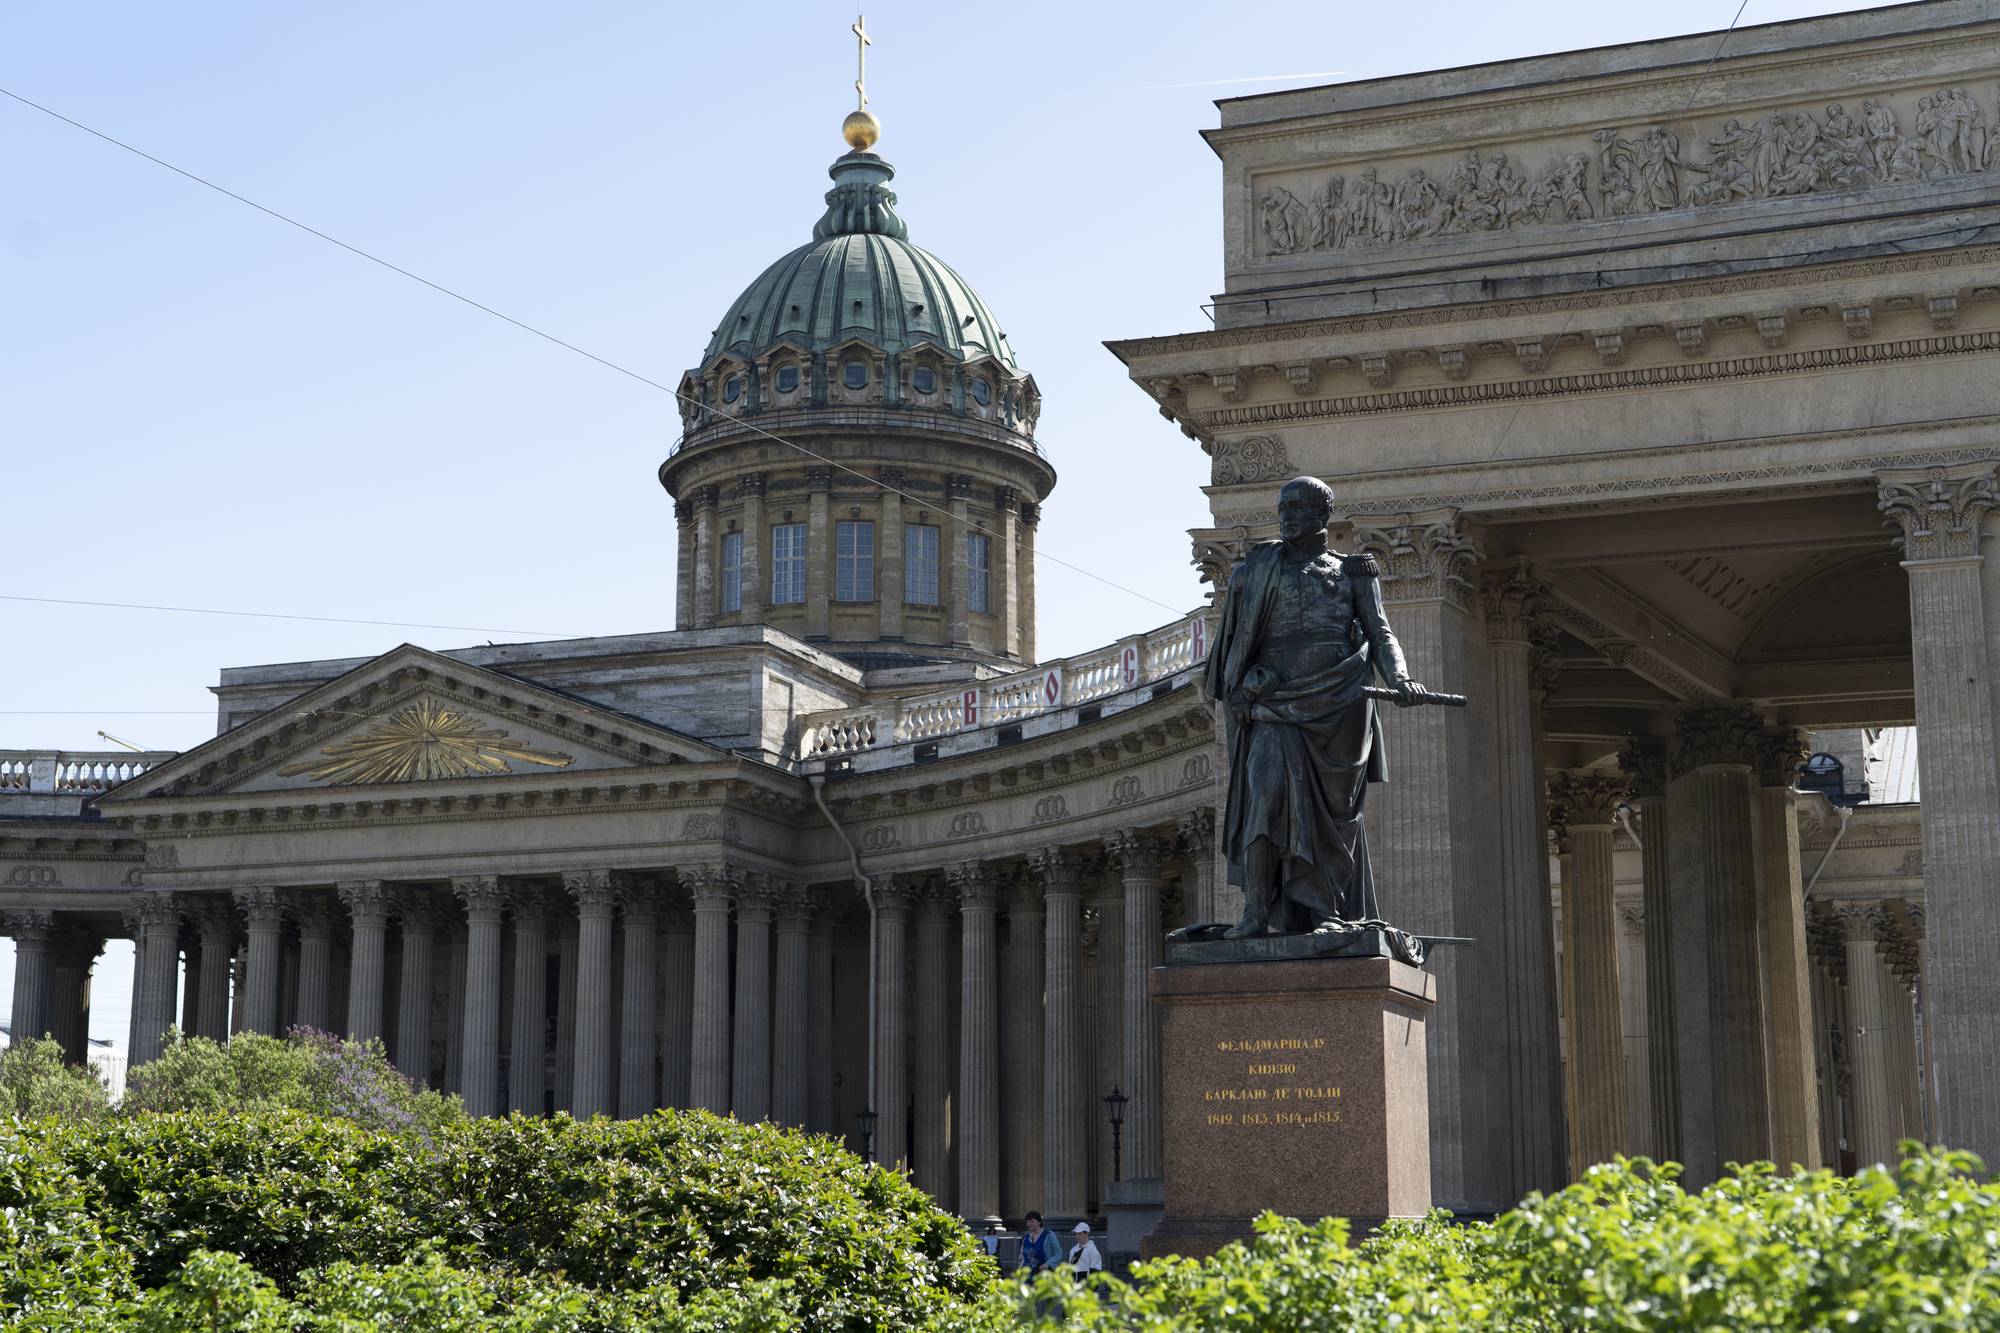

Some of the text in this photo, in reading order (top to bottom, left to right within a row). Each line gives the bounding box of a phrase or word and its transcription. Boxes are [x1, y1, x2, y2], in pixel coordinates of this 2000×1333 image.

[1217, 1037, 1327, 1053] ФЕЛЬДМАРШАЛУ
[1248, 1064, 1296, 1075] КНЯЗЮ
[1206, 1087, 1341, 1101] БАРКЛАЮ ДЕ ТОЛЛИ
